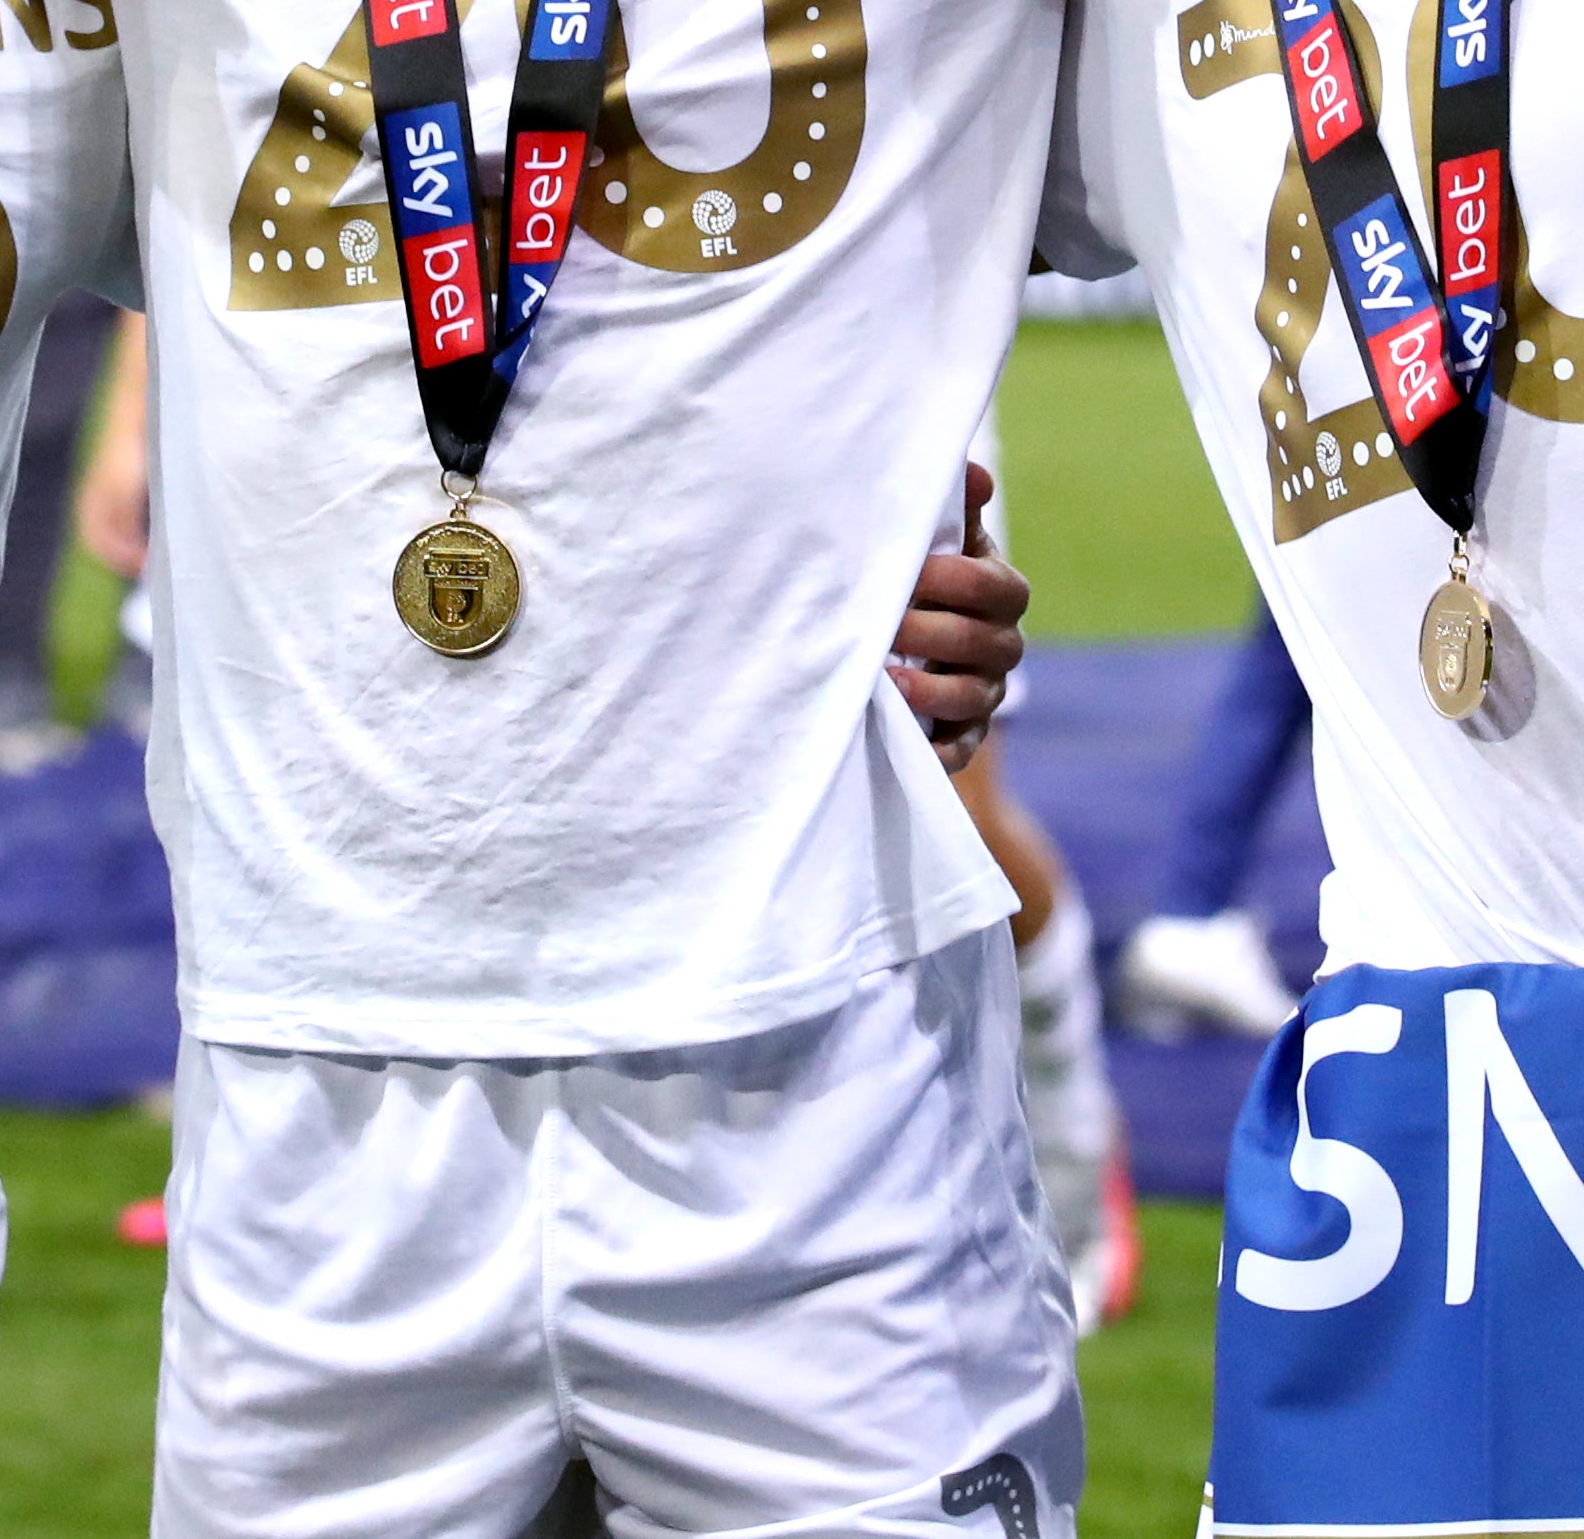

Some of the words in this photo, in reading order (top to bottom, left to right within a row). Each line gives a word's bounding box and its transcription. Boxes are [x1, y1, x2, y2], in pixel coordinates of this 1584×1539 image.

[1300, 27, 1348, 140] bet
[402, 121, 458, 218] sky
[516, 146, 566, 249] bet
[700, 236, 737, 258] EFL
[1449, 167, 1486, 282] bet
[345, 266, 377, 286] EFL
[422, 238, 476, 350] bet
[1351, 218, 1414, 310] sky
[1388, 321, 1437, 422] bet
[1455, 303, 1493, 393] ky
[1325, 476, 1348, 501] EFL
